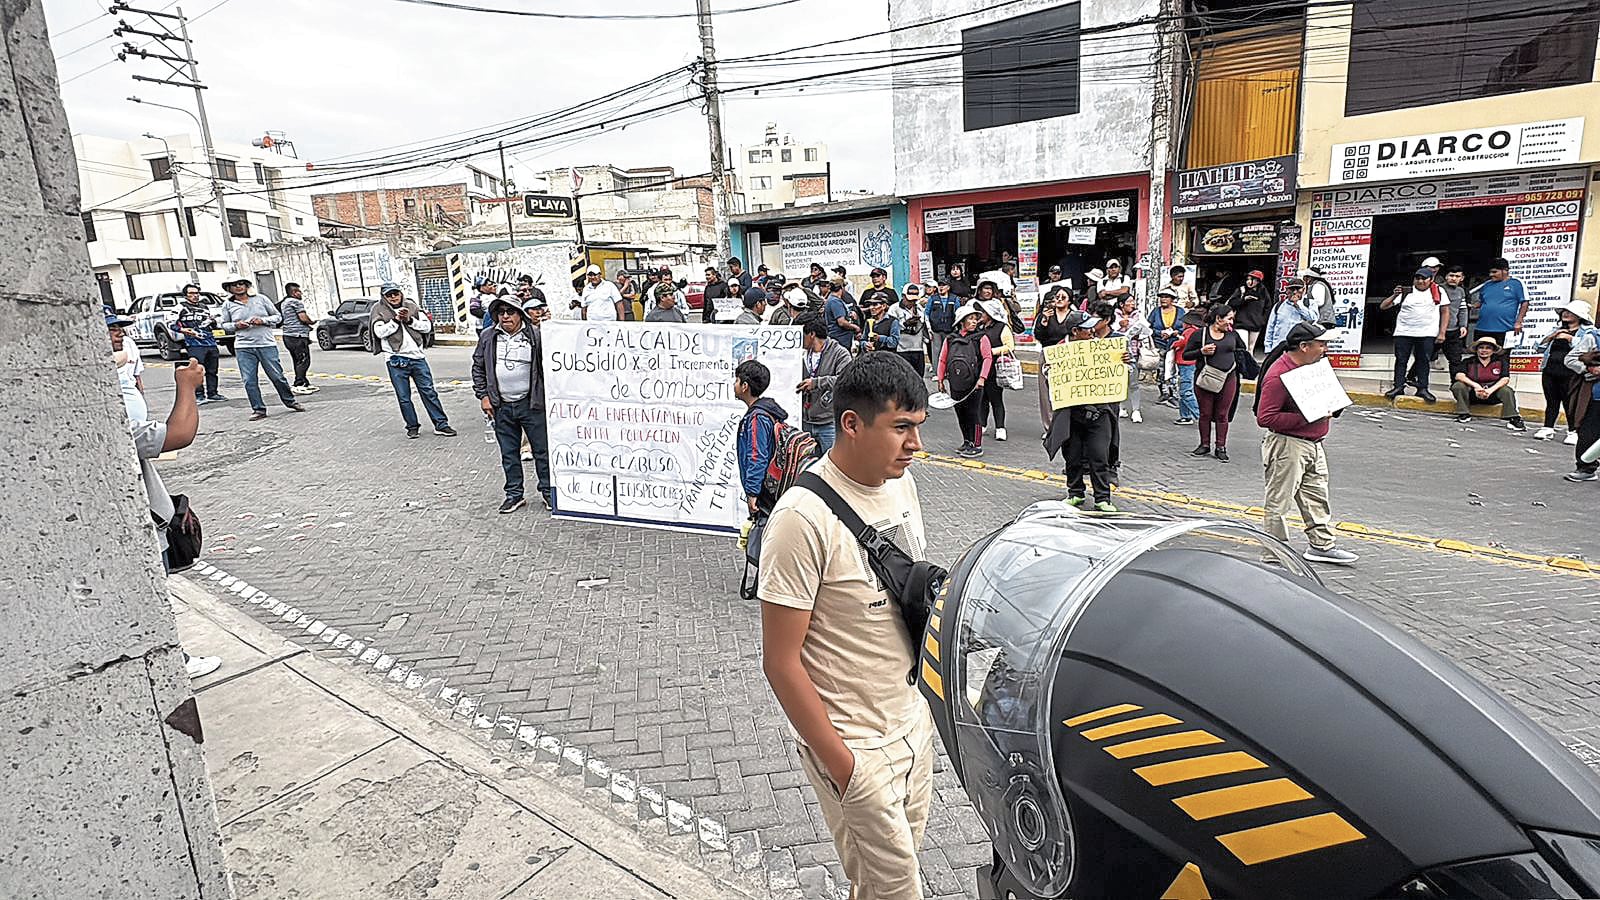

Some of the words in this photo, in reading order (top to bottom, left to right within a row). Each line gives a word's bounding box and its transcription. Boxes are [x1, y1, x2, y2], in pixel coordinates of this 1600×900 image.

[1377, 130, 1511, 160] DIARCO
[1335, 183, 1437, 202] DIARCO
[1525, 193, 1542, 202] 965
[1546, 192, 1562, 200] 728
[1566, 190, 1584, 198] 091
[530, 199, 568, 211] PLAYA
[1056, 199, 1129, 212] IMPRESIONES
[1173, 202, 1217, 215] Restaurante
[1218, 201, 1233, 209] con
[1234, 198, 1258, 207] Sabor
[1259, 198, 1265, 206] y
[1522, 203, 1578, 218] DIARCO
[1059, 216, 1119, 227] COPIAS
[1327, 218, 1371, 230] DIARCO
[782, 234, 811, 242] PROPIEDAD
[828, 237, 857, 245] AREQUIPA
[1512, 237, 1530, 246] 965
[1534, 235, 1553, 244] 728
[1556, 234, 1575, 243] 091
[1312, 254, 1362, 262] PROMUEVE
[1515, 251, 1560, 259] CONSTRUYE
[1047, 344, 1069, 361] SUBA
[1074, 342, 1084, 354] DE
[1090, 338, 1124, 352] PASAJE
[670, 354, 729, 371] Incremento
[1093, 353, 1111, 366] POR
[1076, 364, 1124, 381] EXCESIVO
[611, 376, 629, 400] de
[1071, 383, 1122, 398] PETROLEO
[549, 402, 581, 420] ALTO
[588, 407, 599, 421] AL
[696, 430, 716, 453] LOS
[556, 451, 602, 468] ABAJO
[679, 413, 742, 515] TRANSPORTISTAS
[591, 480, 612, 498] LOS
[620, 483, 685, 500] INSPECTORES
